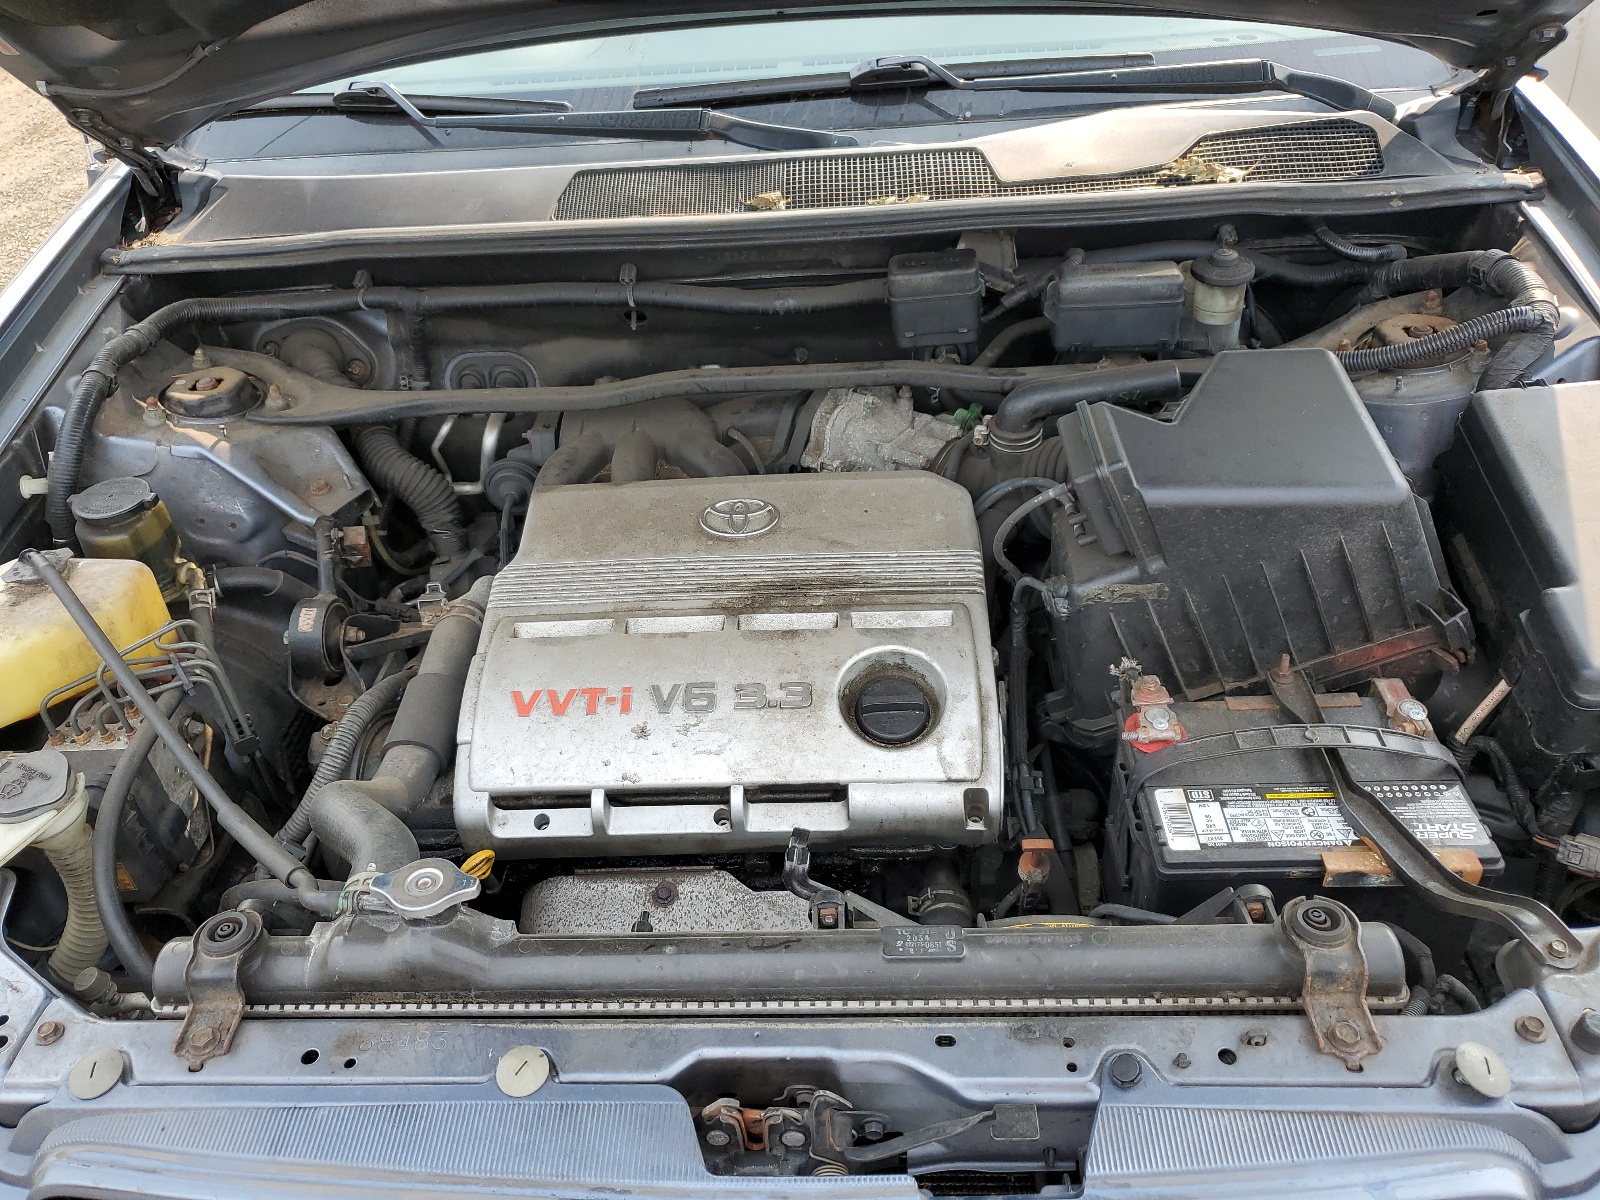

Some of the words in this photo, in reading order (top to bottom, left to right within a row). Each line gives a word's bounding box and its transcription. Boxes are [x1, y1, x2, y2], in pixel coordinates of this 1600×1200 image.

[511, 686, 632, 717] VVT-i
[650, 682, 717, 714] V6
[733, 682, 813, 709] 3.3
[1191, 790, 1210, 798] STD
[1414, 823, 1478, 832] START
[1415, 831, 1474, 840] SUPER
